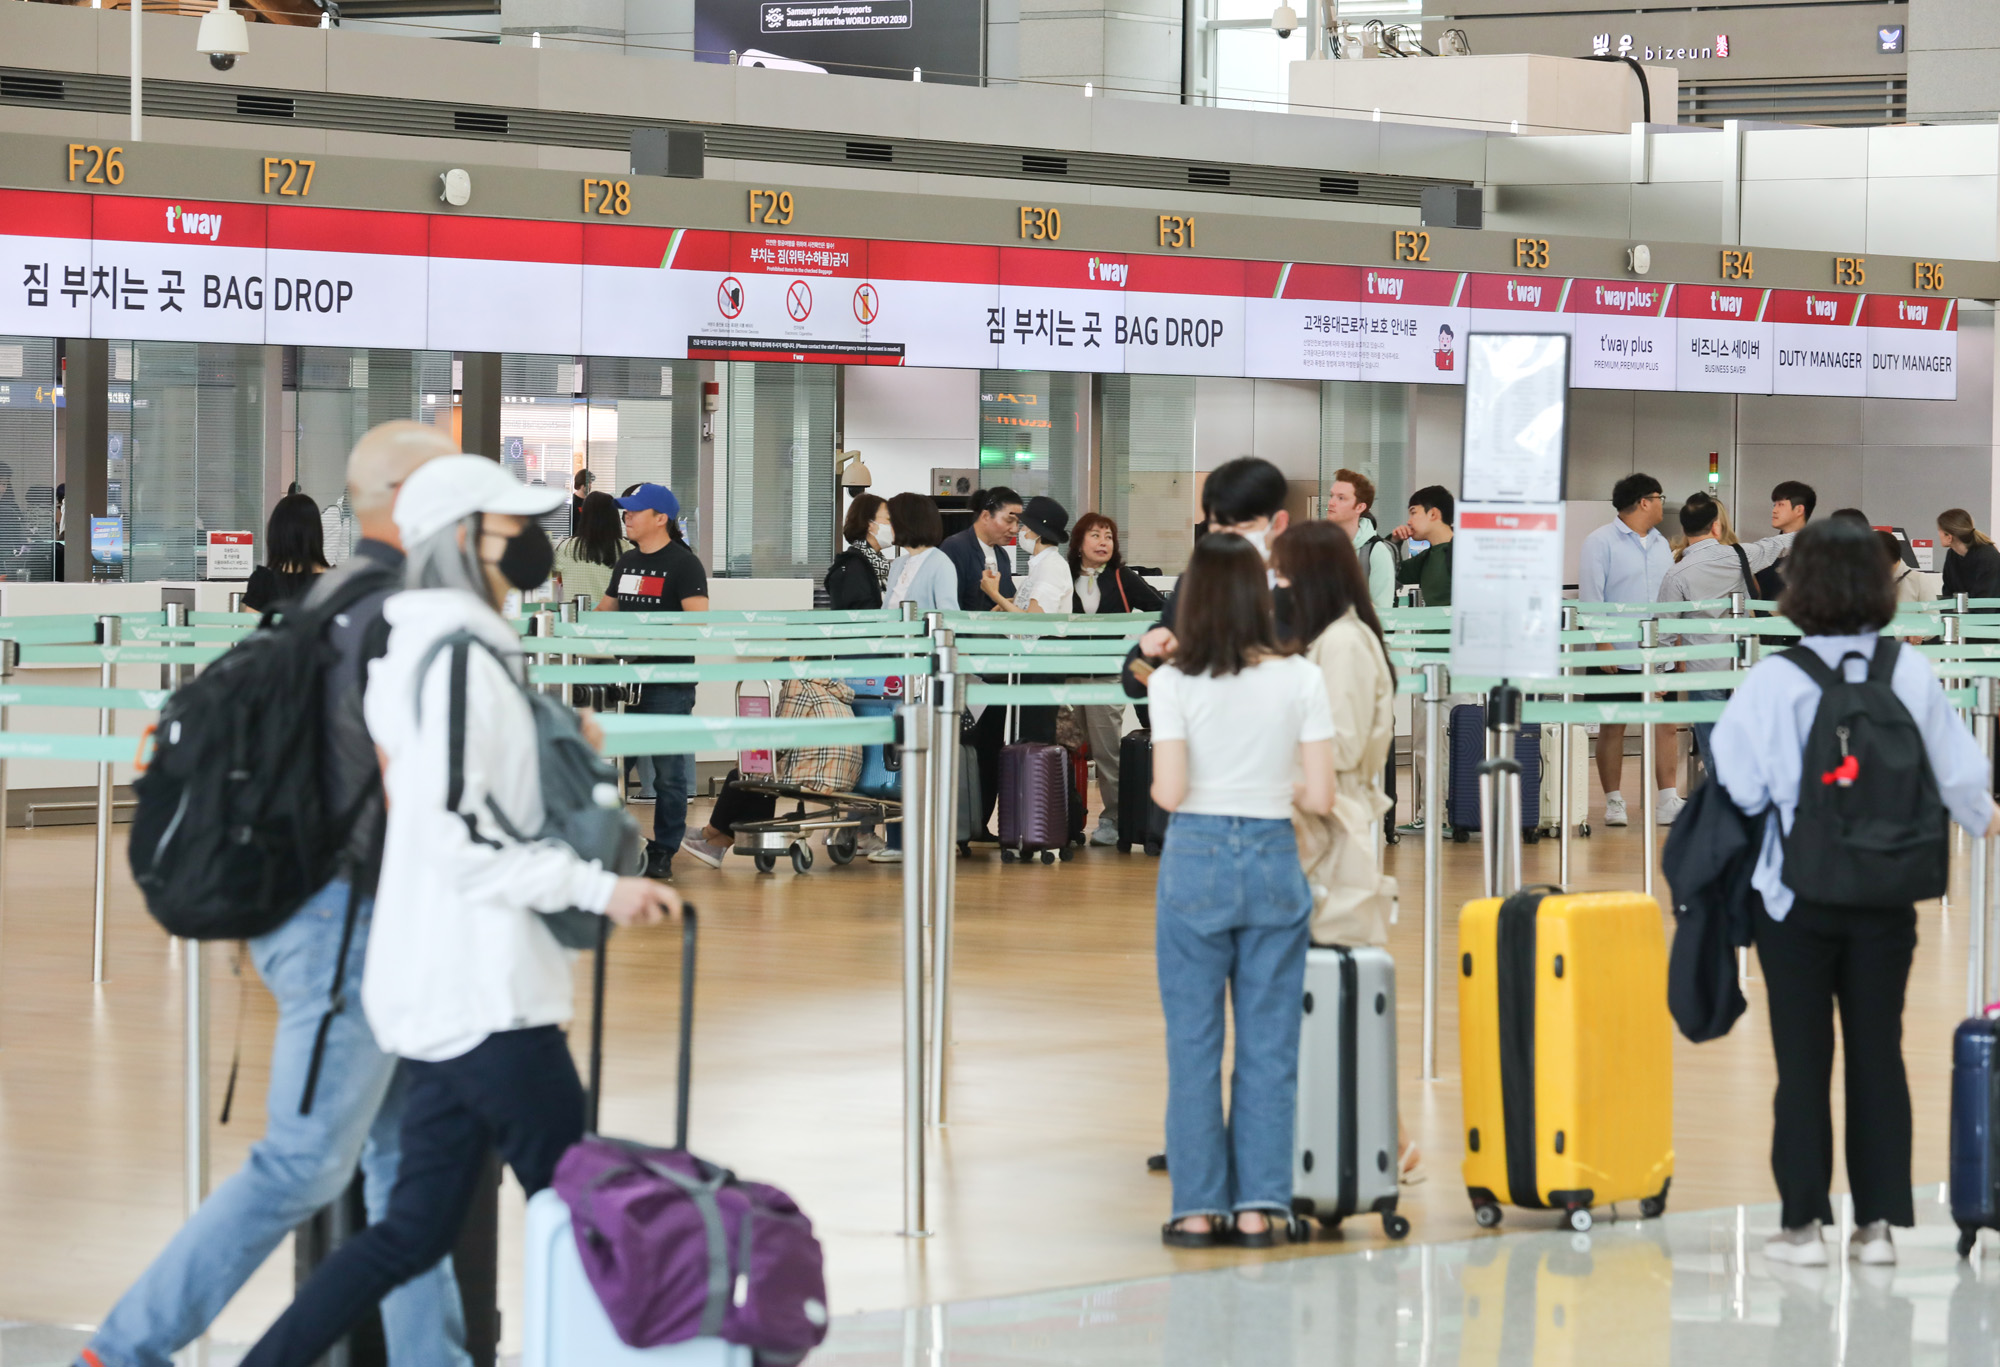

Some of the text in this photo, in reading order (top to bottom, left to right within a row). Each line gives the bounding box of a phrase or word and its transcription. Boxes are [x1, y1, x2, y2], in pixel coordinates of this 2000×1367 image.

[786, 5, 872, 17] Samsung proudly supports
[786, 15, 907, 27] Busan's Bid for the WORLD EXPO 2030
[1645, 46, 1712, 60] bizeun
[68, 144, 125, 185] F26
[263, 158, 316, 196] F27
[583, 179, 632, 215] F28
[749, 190, 794, 225] F29
[166, 205, 222, 241] t'way
[1020, 206, 1061, 240] F30
[1159, 215, 1196, 248] F31
[750, 248, 776, 263] 부치는
[1394, 230, 1431, 262] F32
[1516, 238, 1550, 268] F33
[1088, 257, 1129, 287] t'way
[1721, 250, 1754, 279] F34
[1836, 257, 1866, 285] F35
[1914, 262, 1945, 290] F36
[23, 263, 186, 313] 짐 부치는 곳
[203, 275, 354, 313] BAG DROP
[1367, 272, 1404, 300] t'way
[1507, 280, 1542, 307] t'way
[1711, 290, 1742, 317] t'way
[1806, 295, 1838, 321] t'way
[1899, 300, 1928, 326] t'way
[986, 307, 1102, 348] 짐 부치는 곳
[1115, 316, 1224, 347] BAG DROP
[1303, 315, 1418, 337] 고객응대근로자 보호 안내문
[1631, 336, 1653, 356] plus
[1691, 337, 1760, 360] 비즈니스 세이버
[1779, 349, 1862, 369] DUTY MANAGER
[1646, 362, 1659, 371] PLUS
[1704, 364, 1746, 374] BUSINESS SAVER
[1872, 353, 1952, 373] DUTY MANAGER
[623, 568, 667, 577] TOMMY
[618, 594, 661, 604] ILFIGER
